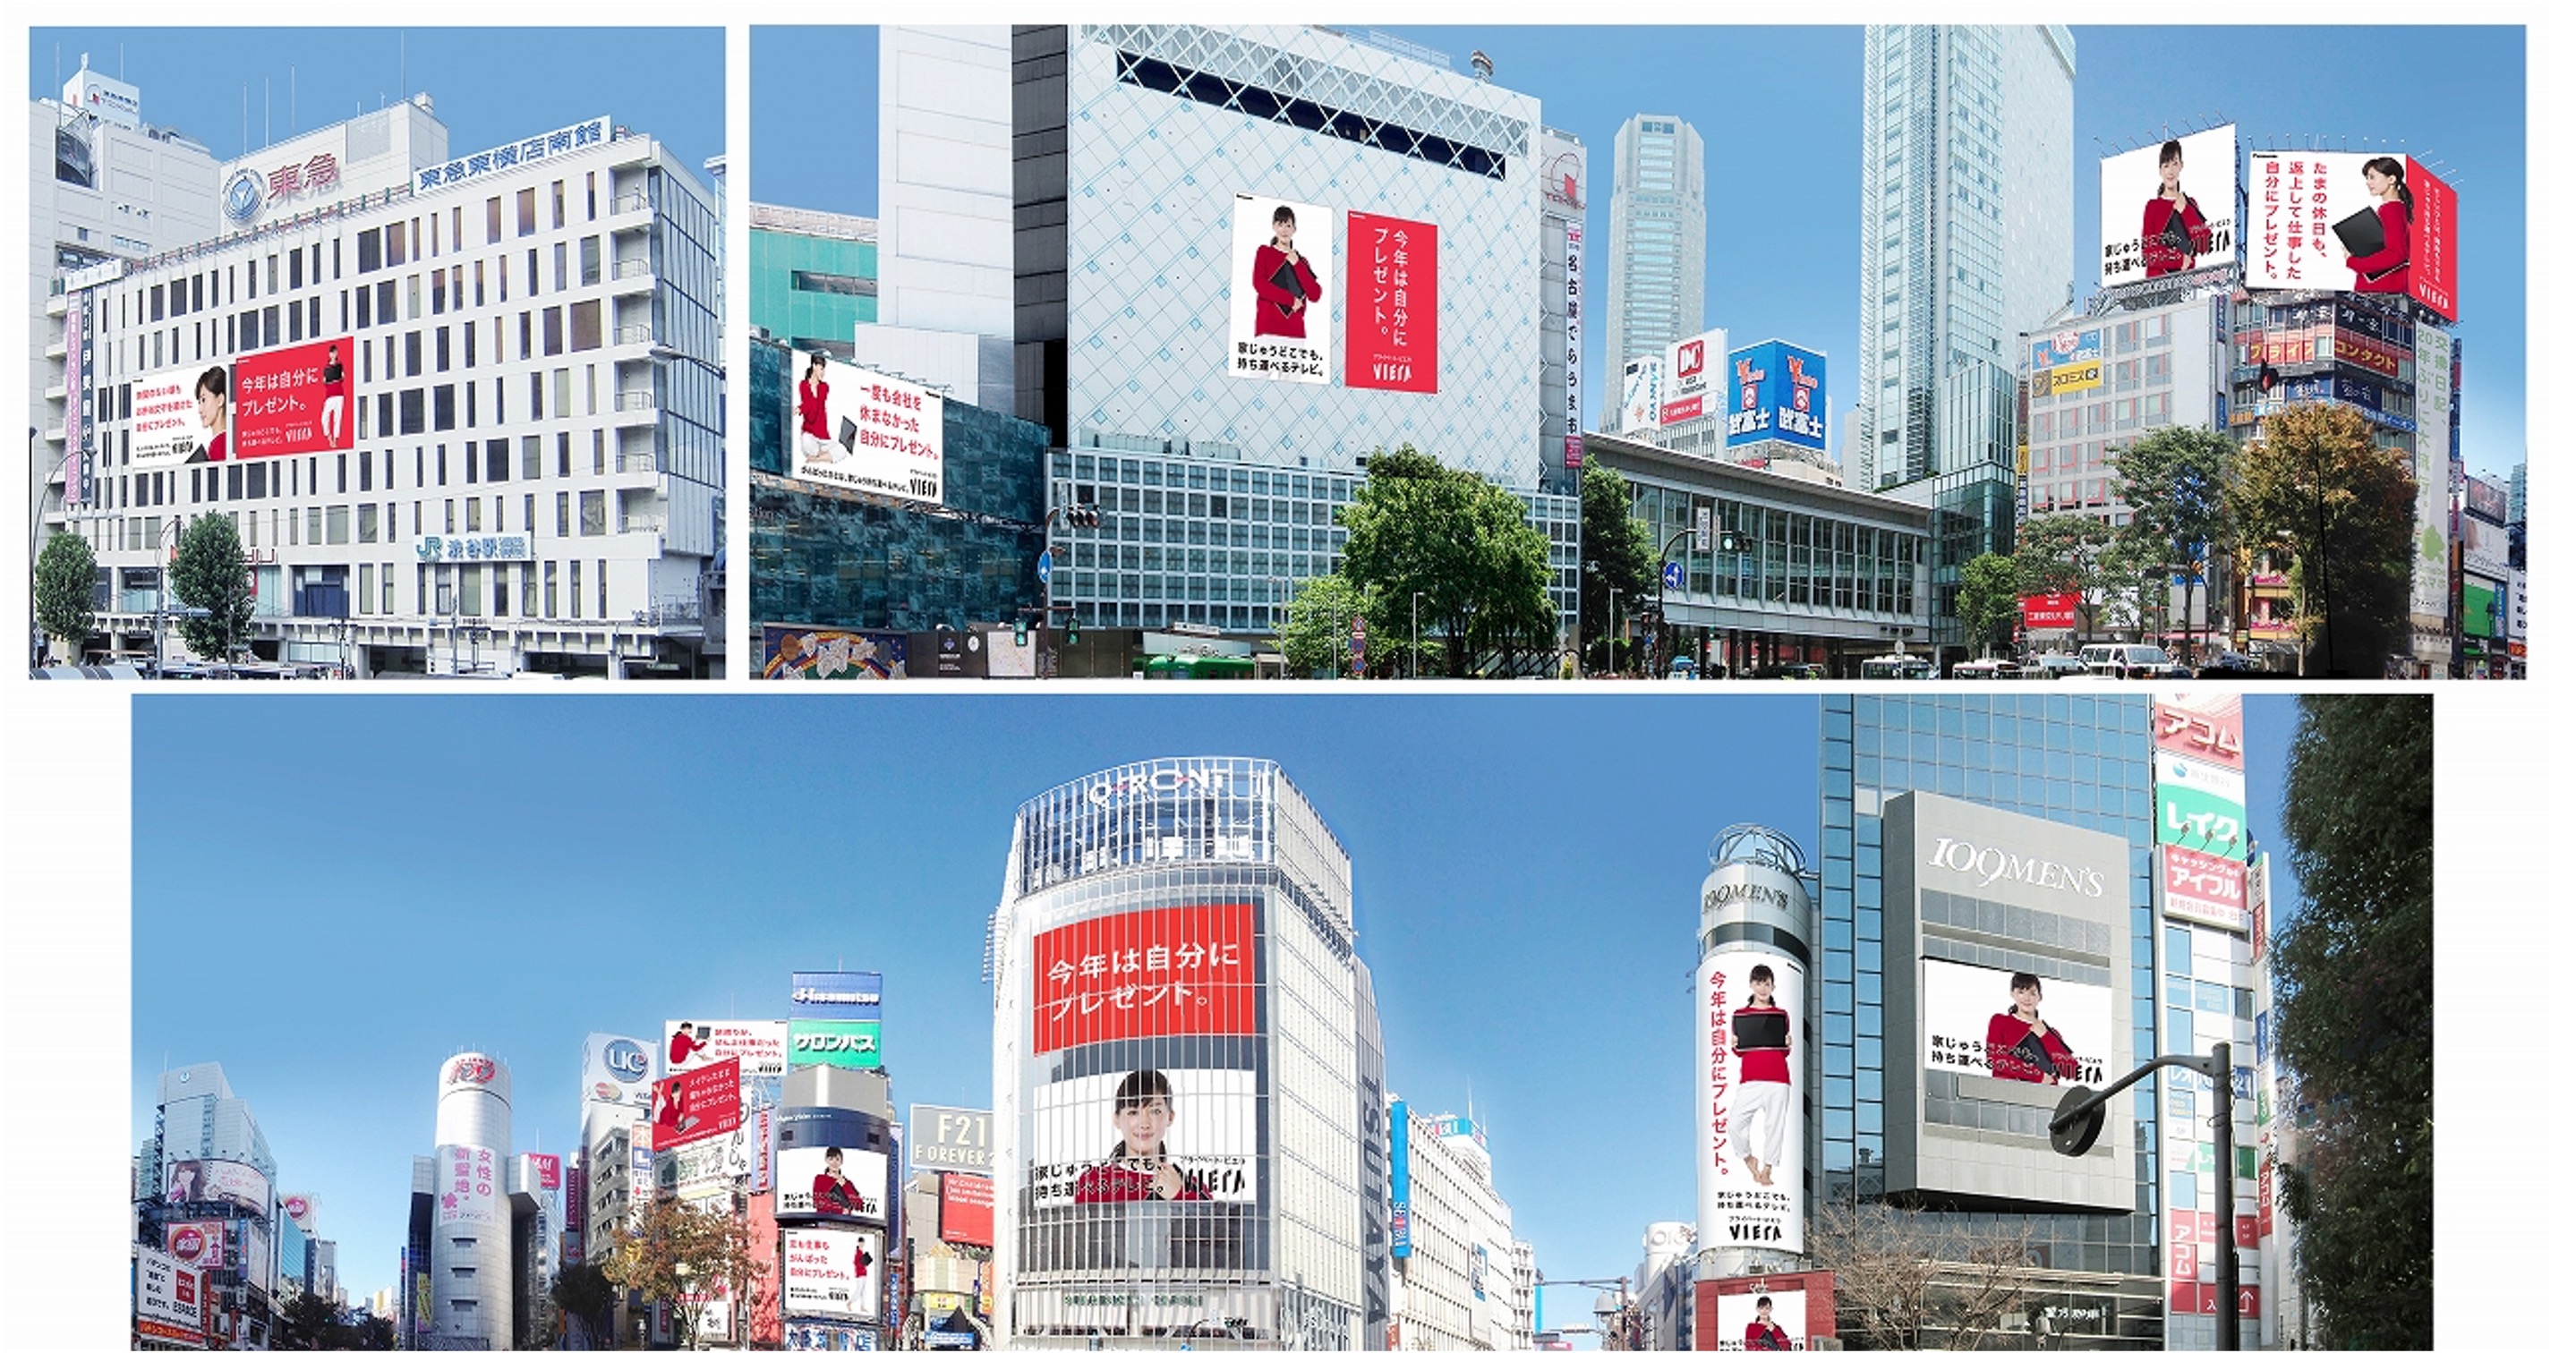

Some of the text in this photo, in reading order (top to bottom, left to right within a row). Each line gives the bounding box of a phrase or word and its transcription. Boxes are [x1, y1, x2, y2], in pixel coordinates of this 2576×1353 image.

[268, 153, 340, 200] 東急
[2264, 161, 2280, 280] 自分にプレゼント。
[2286, 161, 2303, 280] 返上して仕事した
[2312, 161, 2327, 258] たまの休日も、
[1373, 227, 1389, 336] プレゼント。
[1393, 229, 1409, 347] 今年は自分に
[1237, 357, 1324, 378] 持ち運べるテレビ。
[1238, 341, 1323, 362] 家じゅうどこでも、
[2335, 339, 2396, 369] コンタクト
[242, 368, 319, 394] 今年は自分に
[860, 384, 921, 412] 一度も会社を
[242, 395, 306, 416] プレゼント。
[860, 404, 919, 433] 休まなかった
[860, 430, 939, 460] 自分にプレゼント。
[416, 537, 442, 555] JR
[2163, 710, 2240, 756] アコム
[2167, 801, 2239, 842] レイク
[2171, 865, 2242, 900] アイフル
[1046, 942, 1240, 985] 今年は自分に
[1052, 979, 1208, 1022] プレゼント。
[793, 1033, 877, 1053] サロンパス
[610, 1048, 645, 1074] UC
[1710, 971, 1729, 1176] 今年は自分にプレゼント。
[937, 1113, 986, 1148] F21
[476, 1148, 491, 1196] 女性の
[916, 1144, 985, 1166] FOREVER
[1358, 1076, 1387, 1324] TSUTAYA
